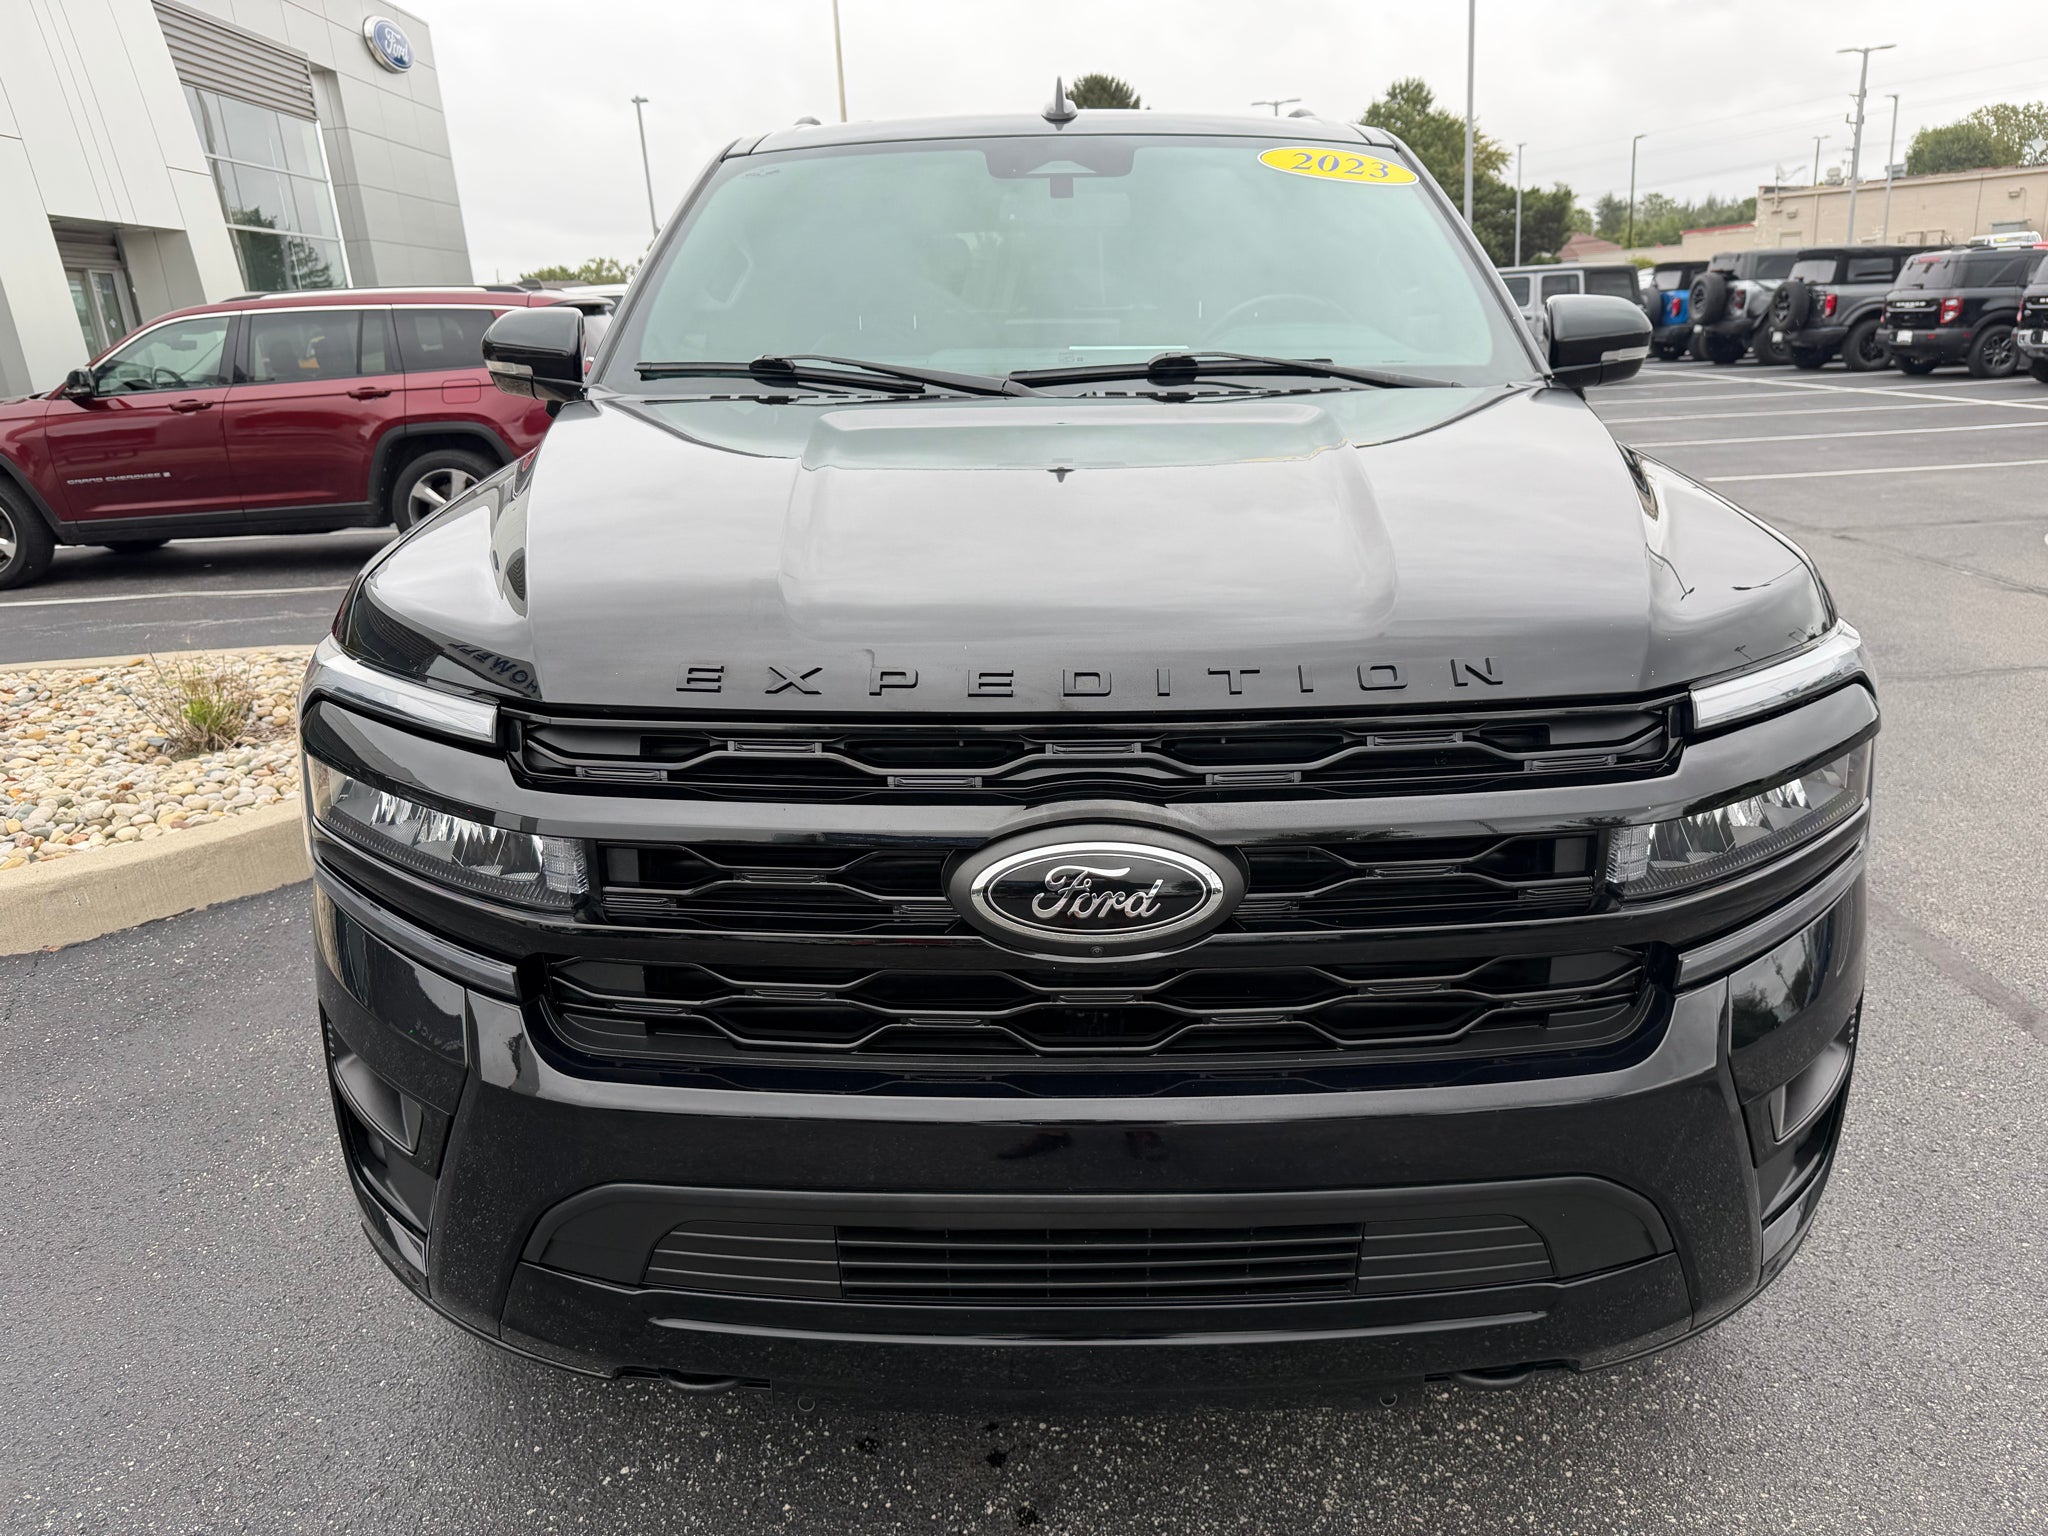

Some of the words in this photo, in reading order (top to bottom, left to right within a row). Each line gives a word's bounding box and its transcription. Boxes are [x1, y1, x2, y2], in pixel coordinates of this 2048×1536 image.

[384, 27, 409, 63] Ford
[1291, 152, 1389, 179] 2023
[676, 656, 1503, 698] EXPEDITION
[1031, 865, 1163, 919] Ford
